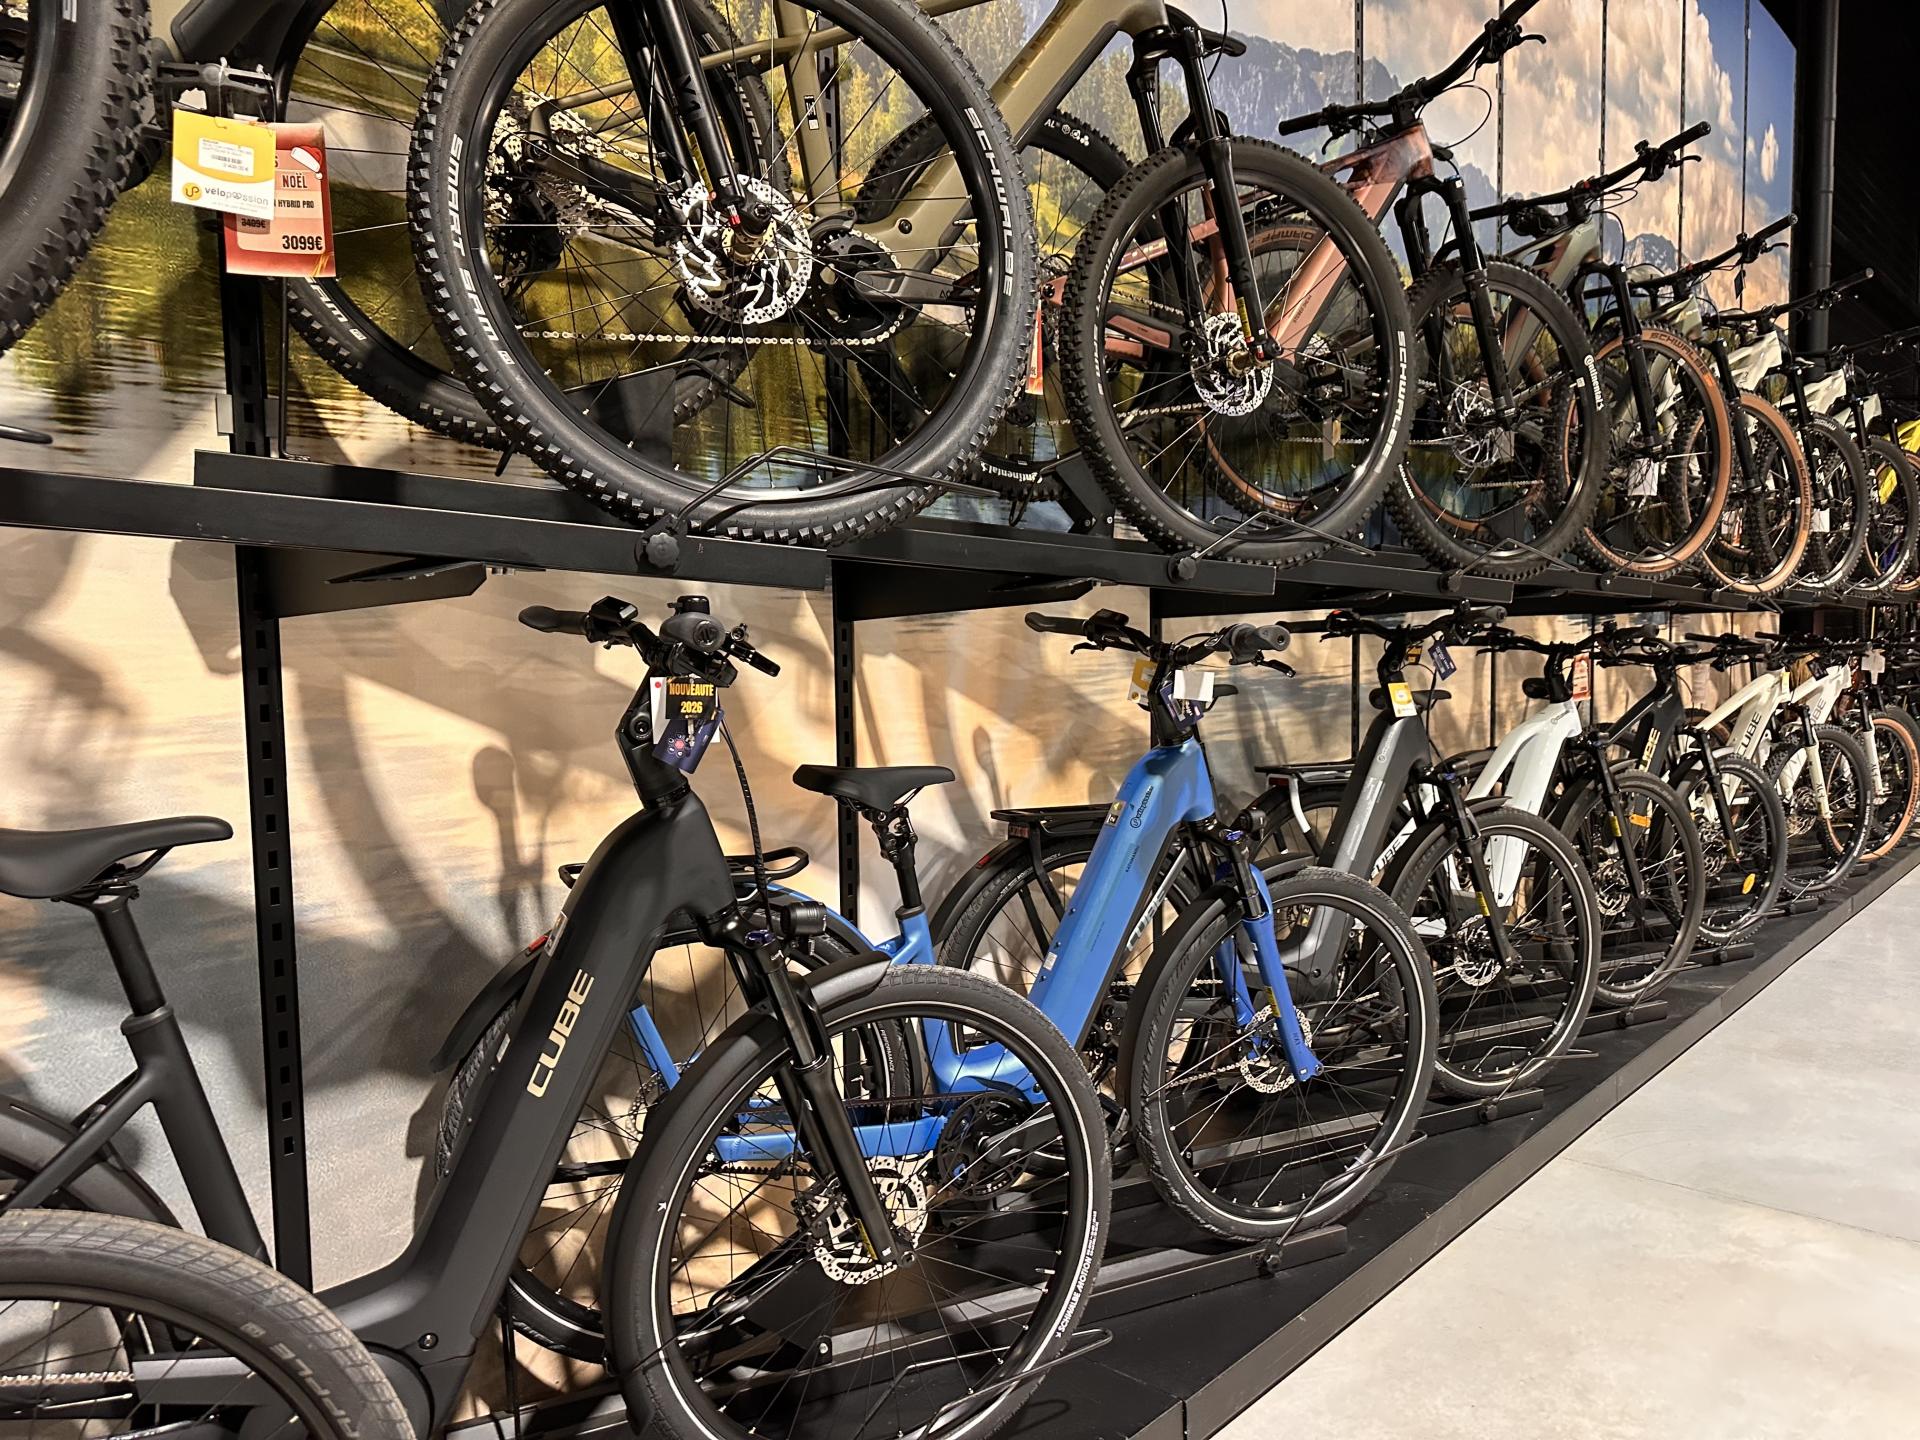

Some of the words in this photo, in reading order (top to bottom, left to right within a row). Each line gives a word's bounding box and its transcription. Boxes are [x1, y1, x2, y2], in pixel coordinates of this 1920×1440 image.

[701, 32, 769, 184] SHWALB
[278, 200, 301, 208] HYBRID
[302, 200, 315, 209] PRO
[282, 172, 308, 189] NOËL
[963, 107, 1014, 297] SCHWALBE
[282, 235, 323, 251] 3099€
[447, 133, 466, 257] SMART
[459, 267, 499, 341] SAM
[1650, 331, 1709, 375] SCHWALBE
[1381, 330, 1407, 458] SCHWALBE
[1797, 459, 1811, 530] SCHWALBE
[680, 700, 703, 713] 2026
[1736, 712, 1762, 756] CUBE
[526, 968, 595, 1098] CUBE
[880, 1029, 895, 1072] PERFORMANCE
[1058, 1291, 1081, 1333] SCHWALBE
[1076, 1255, 1093, 1293] MOTION
[269, 1343, 361, 1439] APPLE
